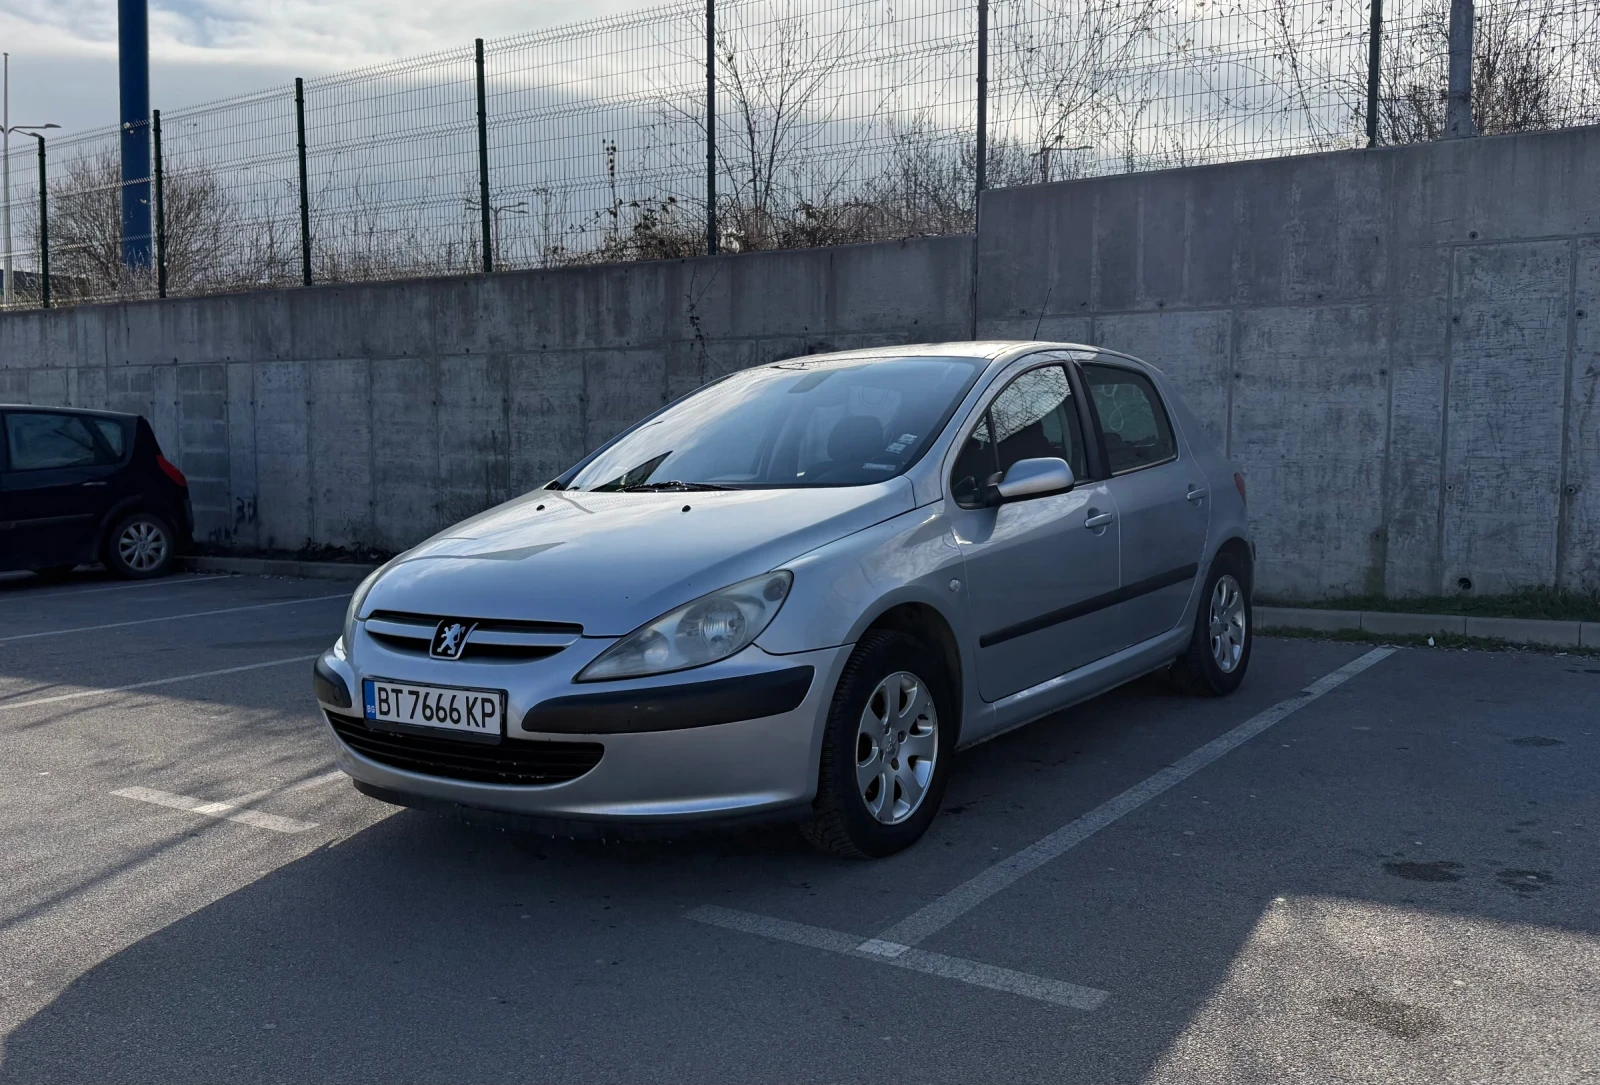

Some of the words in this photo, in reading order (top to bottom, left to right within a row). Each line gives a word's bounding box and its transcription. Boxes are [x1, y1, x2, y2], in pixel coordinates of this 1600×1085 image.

[366, 705, 376, 714] BG
[378, 687, 403, 718] BT
[408, 691, 461, 725] 7666
[466, 696, 496, 728] KP
